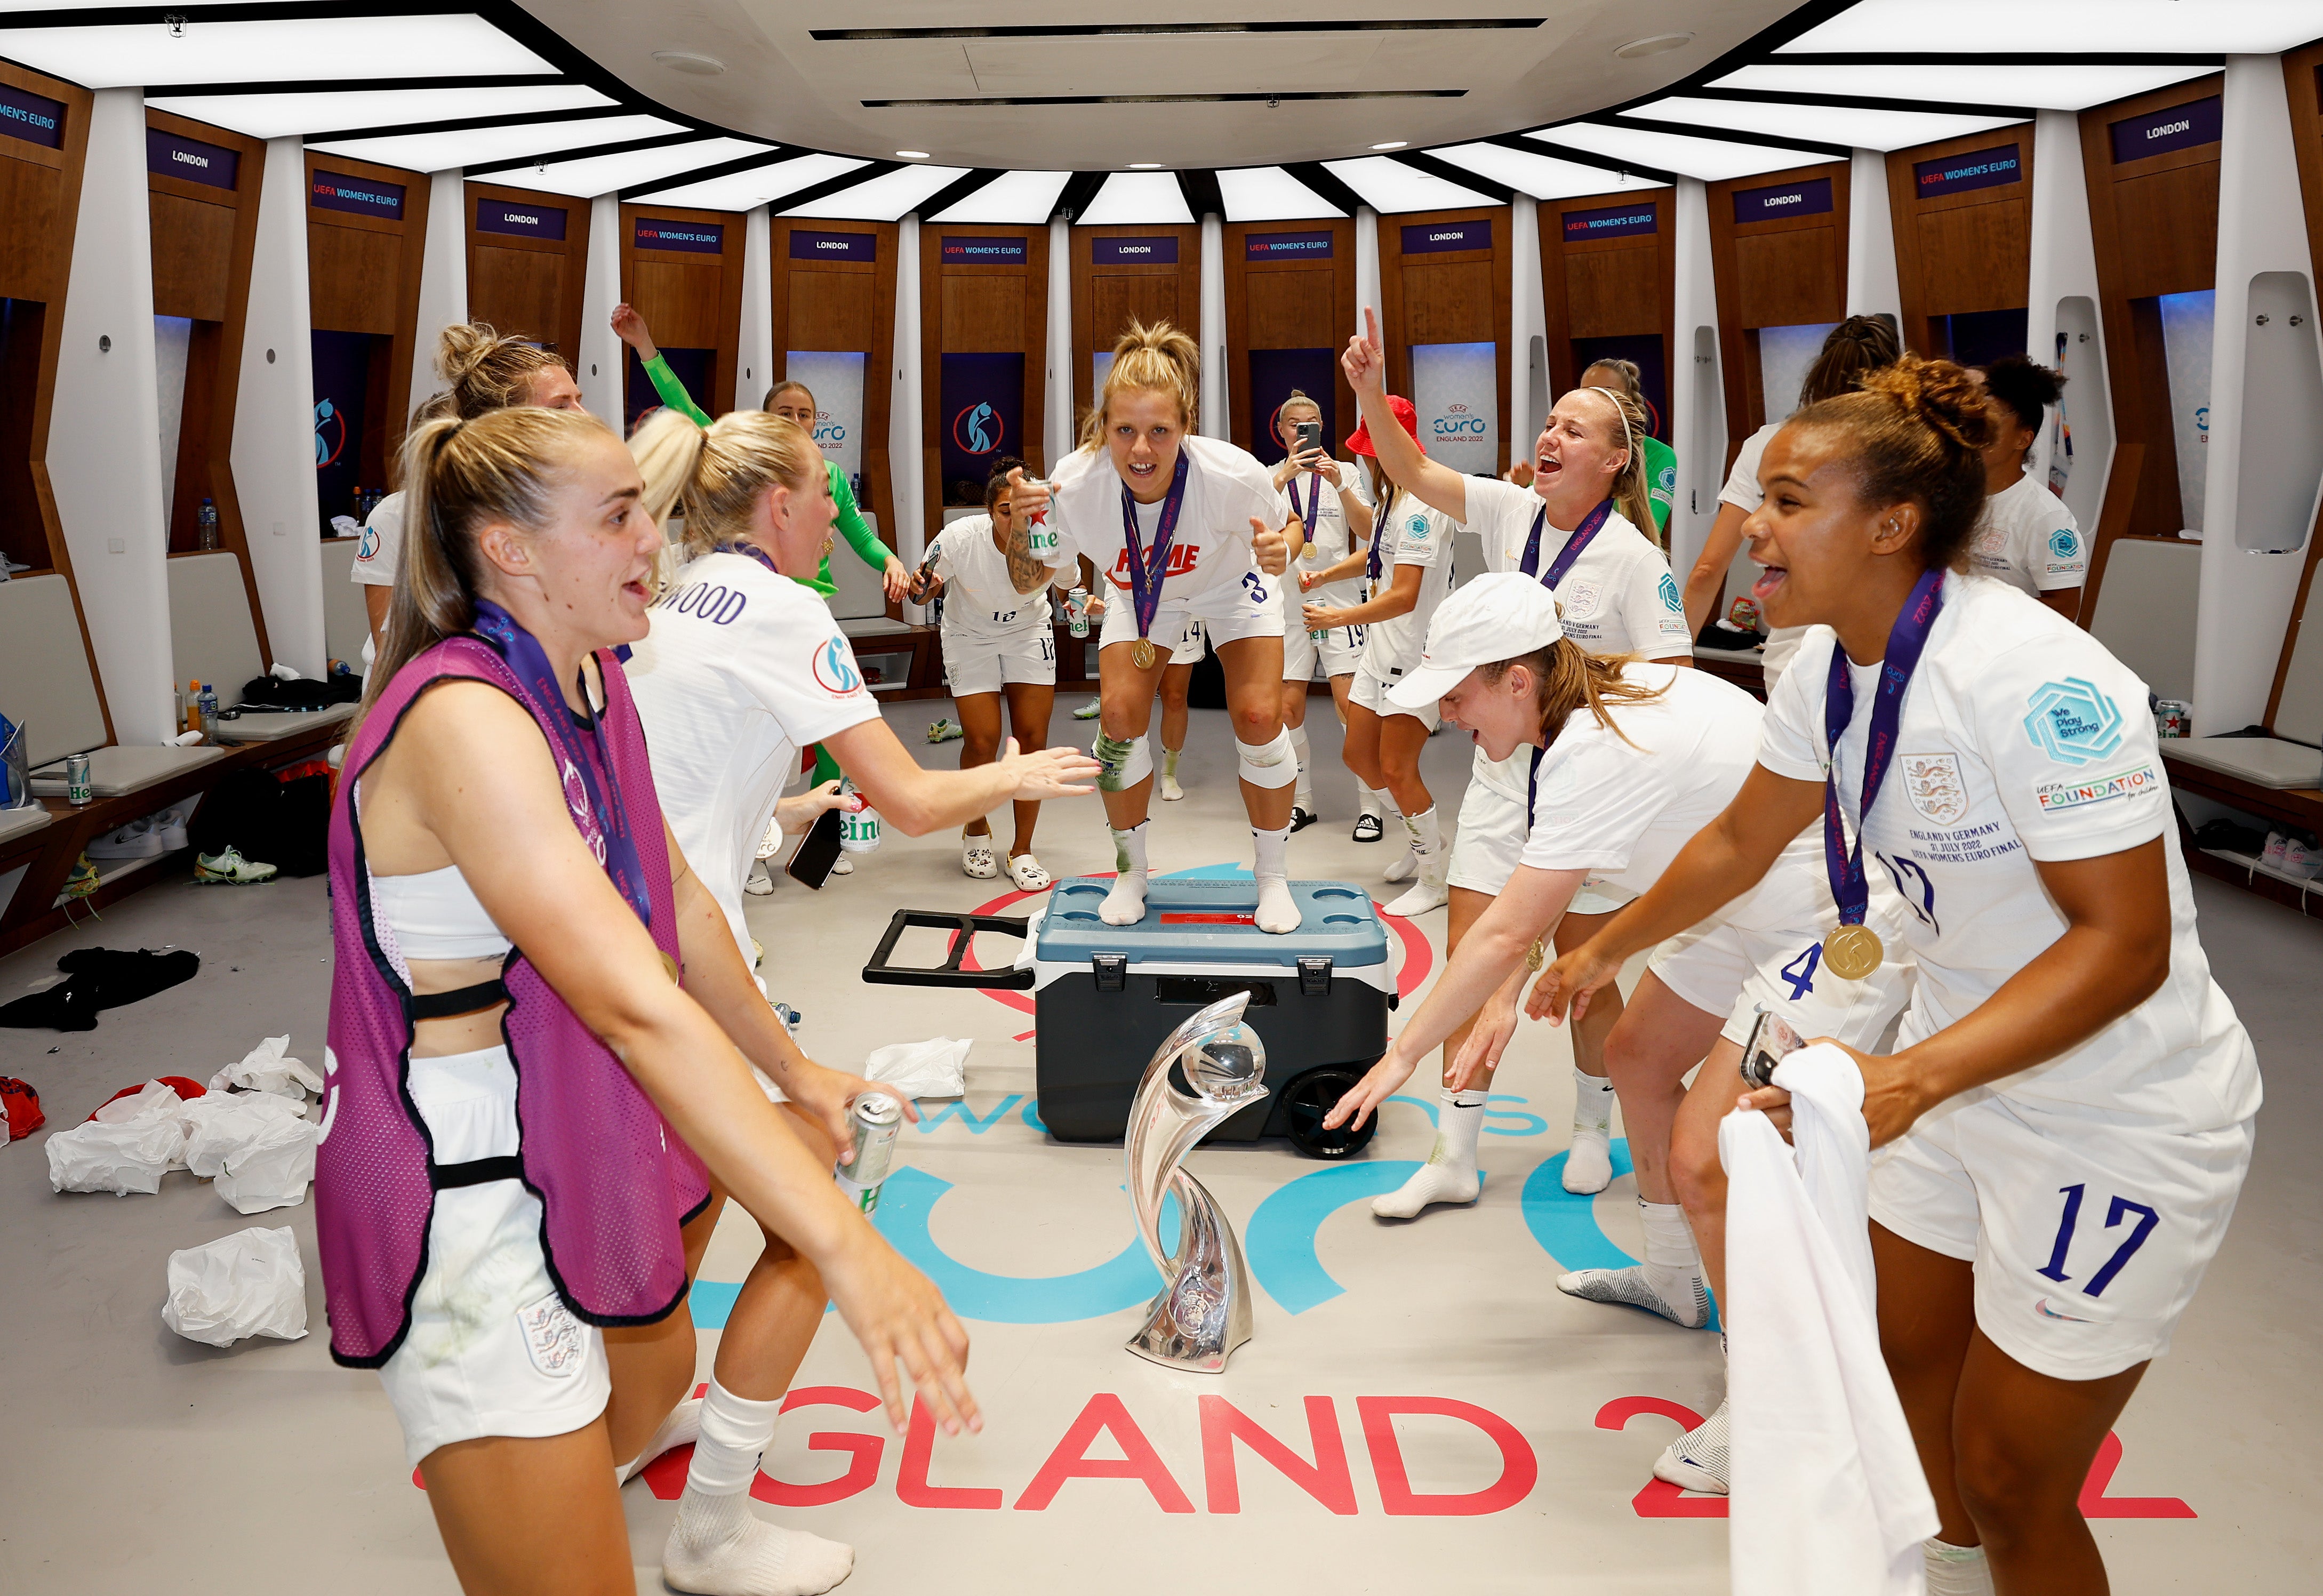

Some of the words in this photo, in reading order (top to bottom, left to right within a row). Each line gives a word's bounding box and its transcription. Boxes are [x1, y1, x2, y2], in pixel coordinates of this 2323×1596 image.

[0, 103, 28, 122] MEN'S
[28, 113, 54, 129] EURO
[2146, 119, 2190, 139] LONDON
[172, 150, 209, 168] LONDON
[1921, 173, 1945, 184] UEFA
[1945, 164, 1988, 180] WOMEN'S
[1990, 159, 2016, 172] EURO
[314, 183, 336, 196] UEFA
[337, 188, 374, 202] WOMEN'S
[376, 195, 397, 206] EURO
[1764, 194, 1802, 207] LONDON
[504, 213, 538, 225] LONDON
[1567, 221, 1589, 230] UEFA
[1589, 217, 1628, 228] WOMEN'S
[1629, 214, 1652, 224] EURO
[659, 231, 695, 240] WOMEN'S
[696, 234, 716, 243] EURO
[816, 241, 848, 250] LONDON
[1270, 242, 1305, 250] WOMEN'S
[1430, 231, 1463, 241] LONDON
[813, 426, 845, 440] uro
[1569, 524, 1594, 551] ENGLAND
[1591, 510, 1603, 525] 2022
[1241, 572, 1268, 604] 3
[647, 582, 747, 625] WOOD
[1182, 621, 1200, 642] 14
[1348, 624, 1365, 648] 19
[2052, 708, 2070, 717] We
[2056, 716, 2082, 728] Play
[2060, 721, 2100, 737] Strong
[2037, 783, 2064, 794] UEFA
[2039, 769, 2155, 807] FOUNDATION
[1910, 829, 1944, 841] ENGLAND
[1945, 832, 1951, 841] V
[1953, 821, 2001, 841] GERMANY
[1911, 849, 1928, 860] UEFA
[1928, 853, 1965, 862] WOMENS
[1965, 848, 1991, 862] EURO
[1992, 839, 2022, 856] FINAL
[1931, 843, 1938, 852] 31
[1941, 843, 1960, 853] JULY
[1962, 839, 1982, 851] 2022
[1781, 942, 1822, 1000] 4
[2035, 1183, 2160, 1297] 17
[651, 1383, 1537, 1516] GLAND
